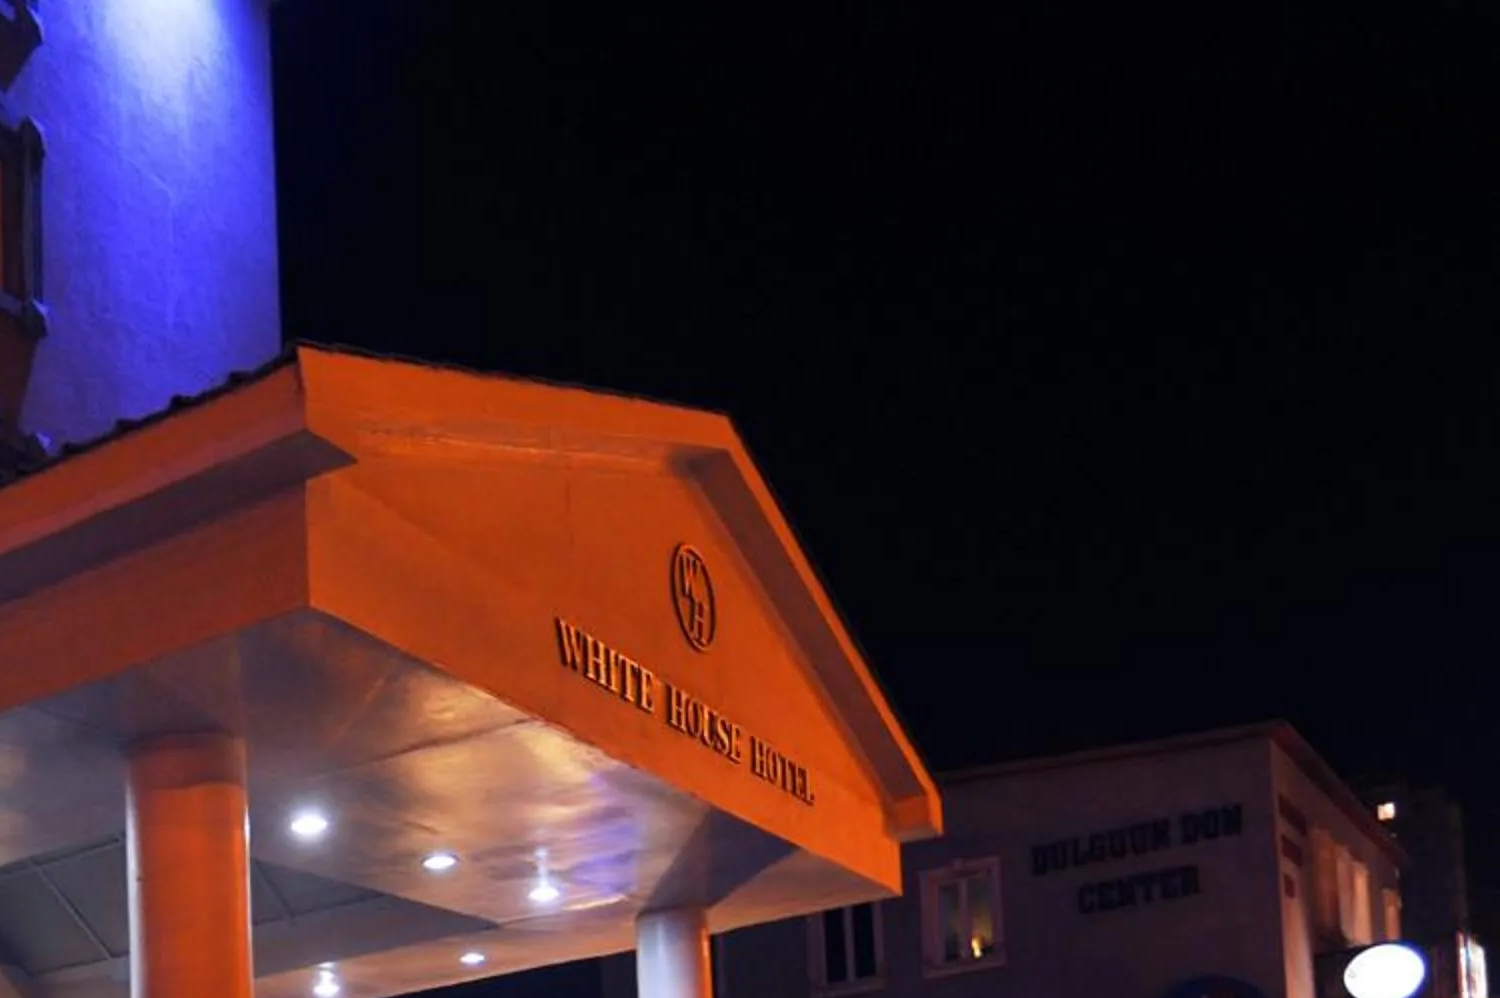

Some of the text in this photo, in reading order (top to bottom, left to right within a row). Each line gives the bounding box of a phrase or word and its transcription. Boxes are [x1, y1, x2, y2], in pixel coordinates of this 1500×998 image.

[555, 616, 815, 806] WHITE HOUSE HOTEL
[1078, 864, 1202, 915] CENTER
